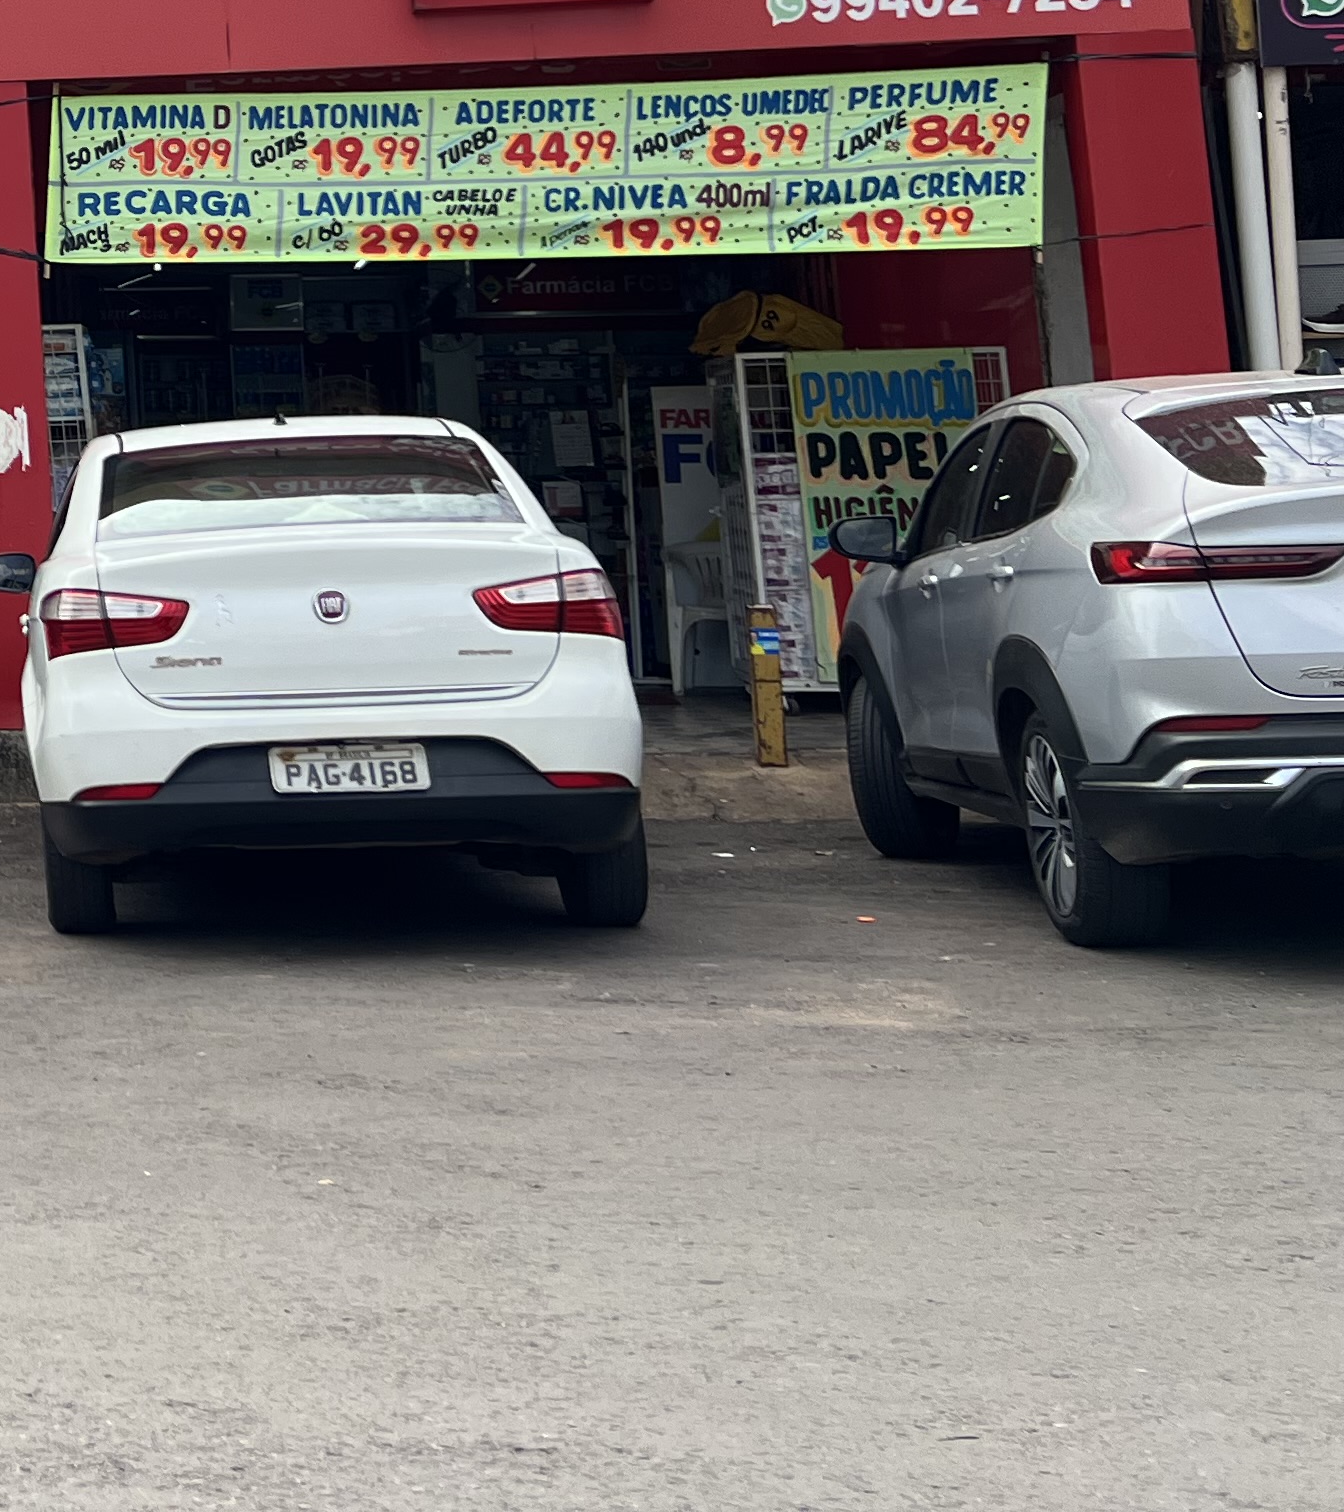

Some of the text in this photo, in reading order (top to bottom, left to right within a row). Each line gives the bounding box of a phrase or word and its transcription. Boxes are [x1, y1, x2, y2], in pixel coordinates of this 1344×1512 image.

[455, 96, 596, 126] ADEFORTE
[636, 91, 732, 122] LENÇOS
[847, 77, 999, 111] PERFUME
[64, 104, 231, 133] VITAMINA D
[248, 102, 420, 131] MELATONINA
[436, 126, 499, 171] TURBO
[500, 129, 618, 175] 44,99
[632, 132, 669, 164] 140
[707, 122, 810, 169] 8,99
[835, 109, 908, 162] LARIVE
[908, 111, 1032, 157] 84,99
[66, 146, 92, 172] 50
[128, 136, 232, 178] 19,99
[250, 131, 309, 170] GOTAS
[311, 135, 422, 179] 19,99
[77, 190, 252, 218] RECARGA
[297, 190, 422, 218] LAVITAN
[694, 181, 771, 209] 400ml
[785, 170, 1027, 206] FRALDA CREMER
[444, 203, 500, 218] UNHA
[843, 204, 975, 250] 19,99
[133, 221, 249, 259] 19,99
[356, 221, 480, 260] 29,99
[599, 214, 723, 253] 19,99
[799, 359, 977, 427] PROMOÇÃO
[659, 407, 711, 430] FAR
[813, 484, 920, 532] HIGIÊN
